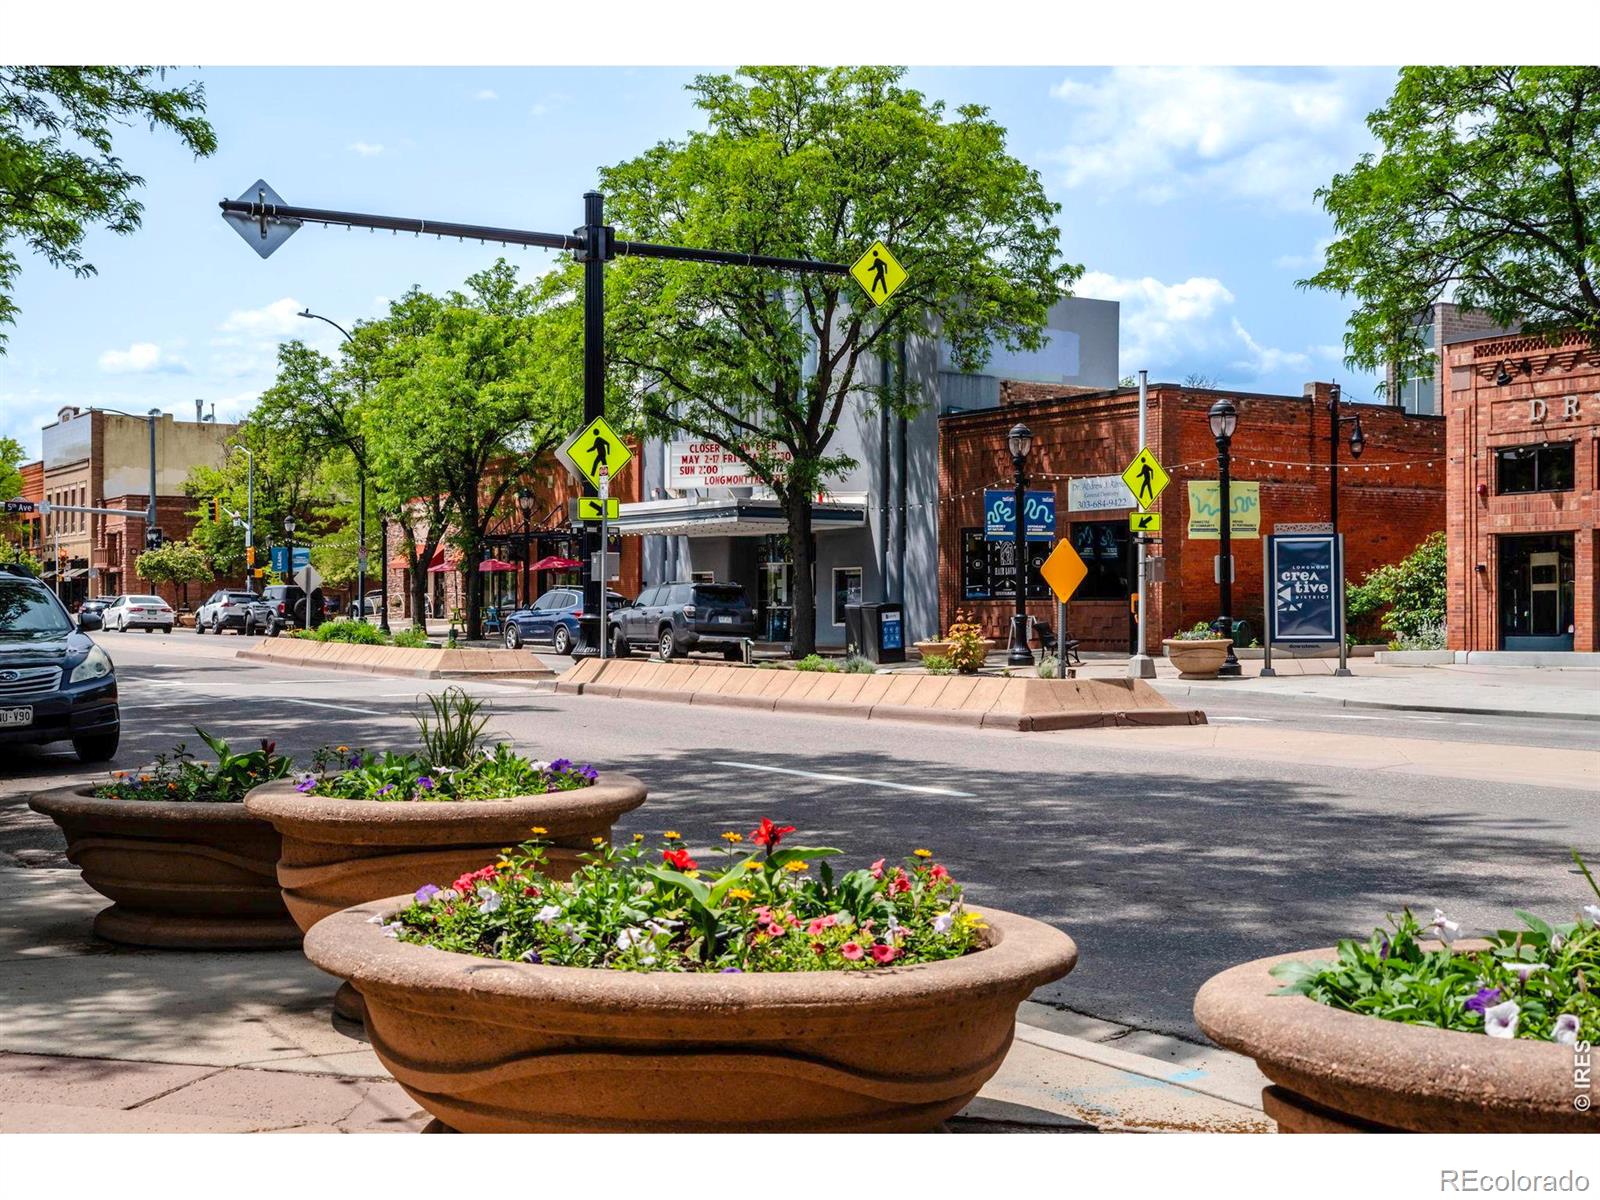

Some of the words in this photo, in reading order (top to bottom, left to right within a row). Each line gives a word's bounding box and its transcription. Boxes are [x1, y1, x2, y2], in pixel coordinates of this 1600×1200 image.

[689, 444, 720, 453] CLOSER
[681, 455, 700, 464] MAY
[704, 454, 720, 464] 2-17
[723, 454, 737, 463] FRI
[680, 466, 695, 475] SUN
[698, 465, 718, 475] 2:00
[704, 475, 747, 485] LONGMONT
[18, 503, 32, 512] Ave
[1295, 581, 1329, 593] tive
